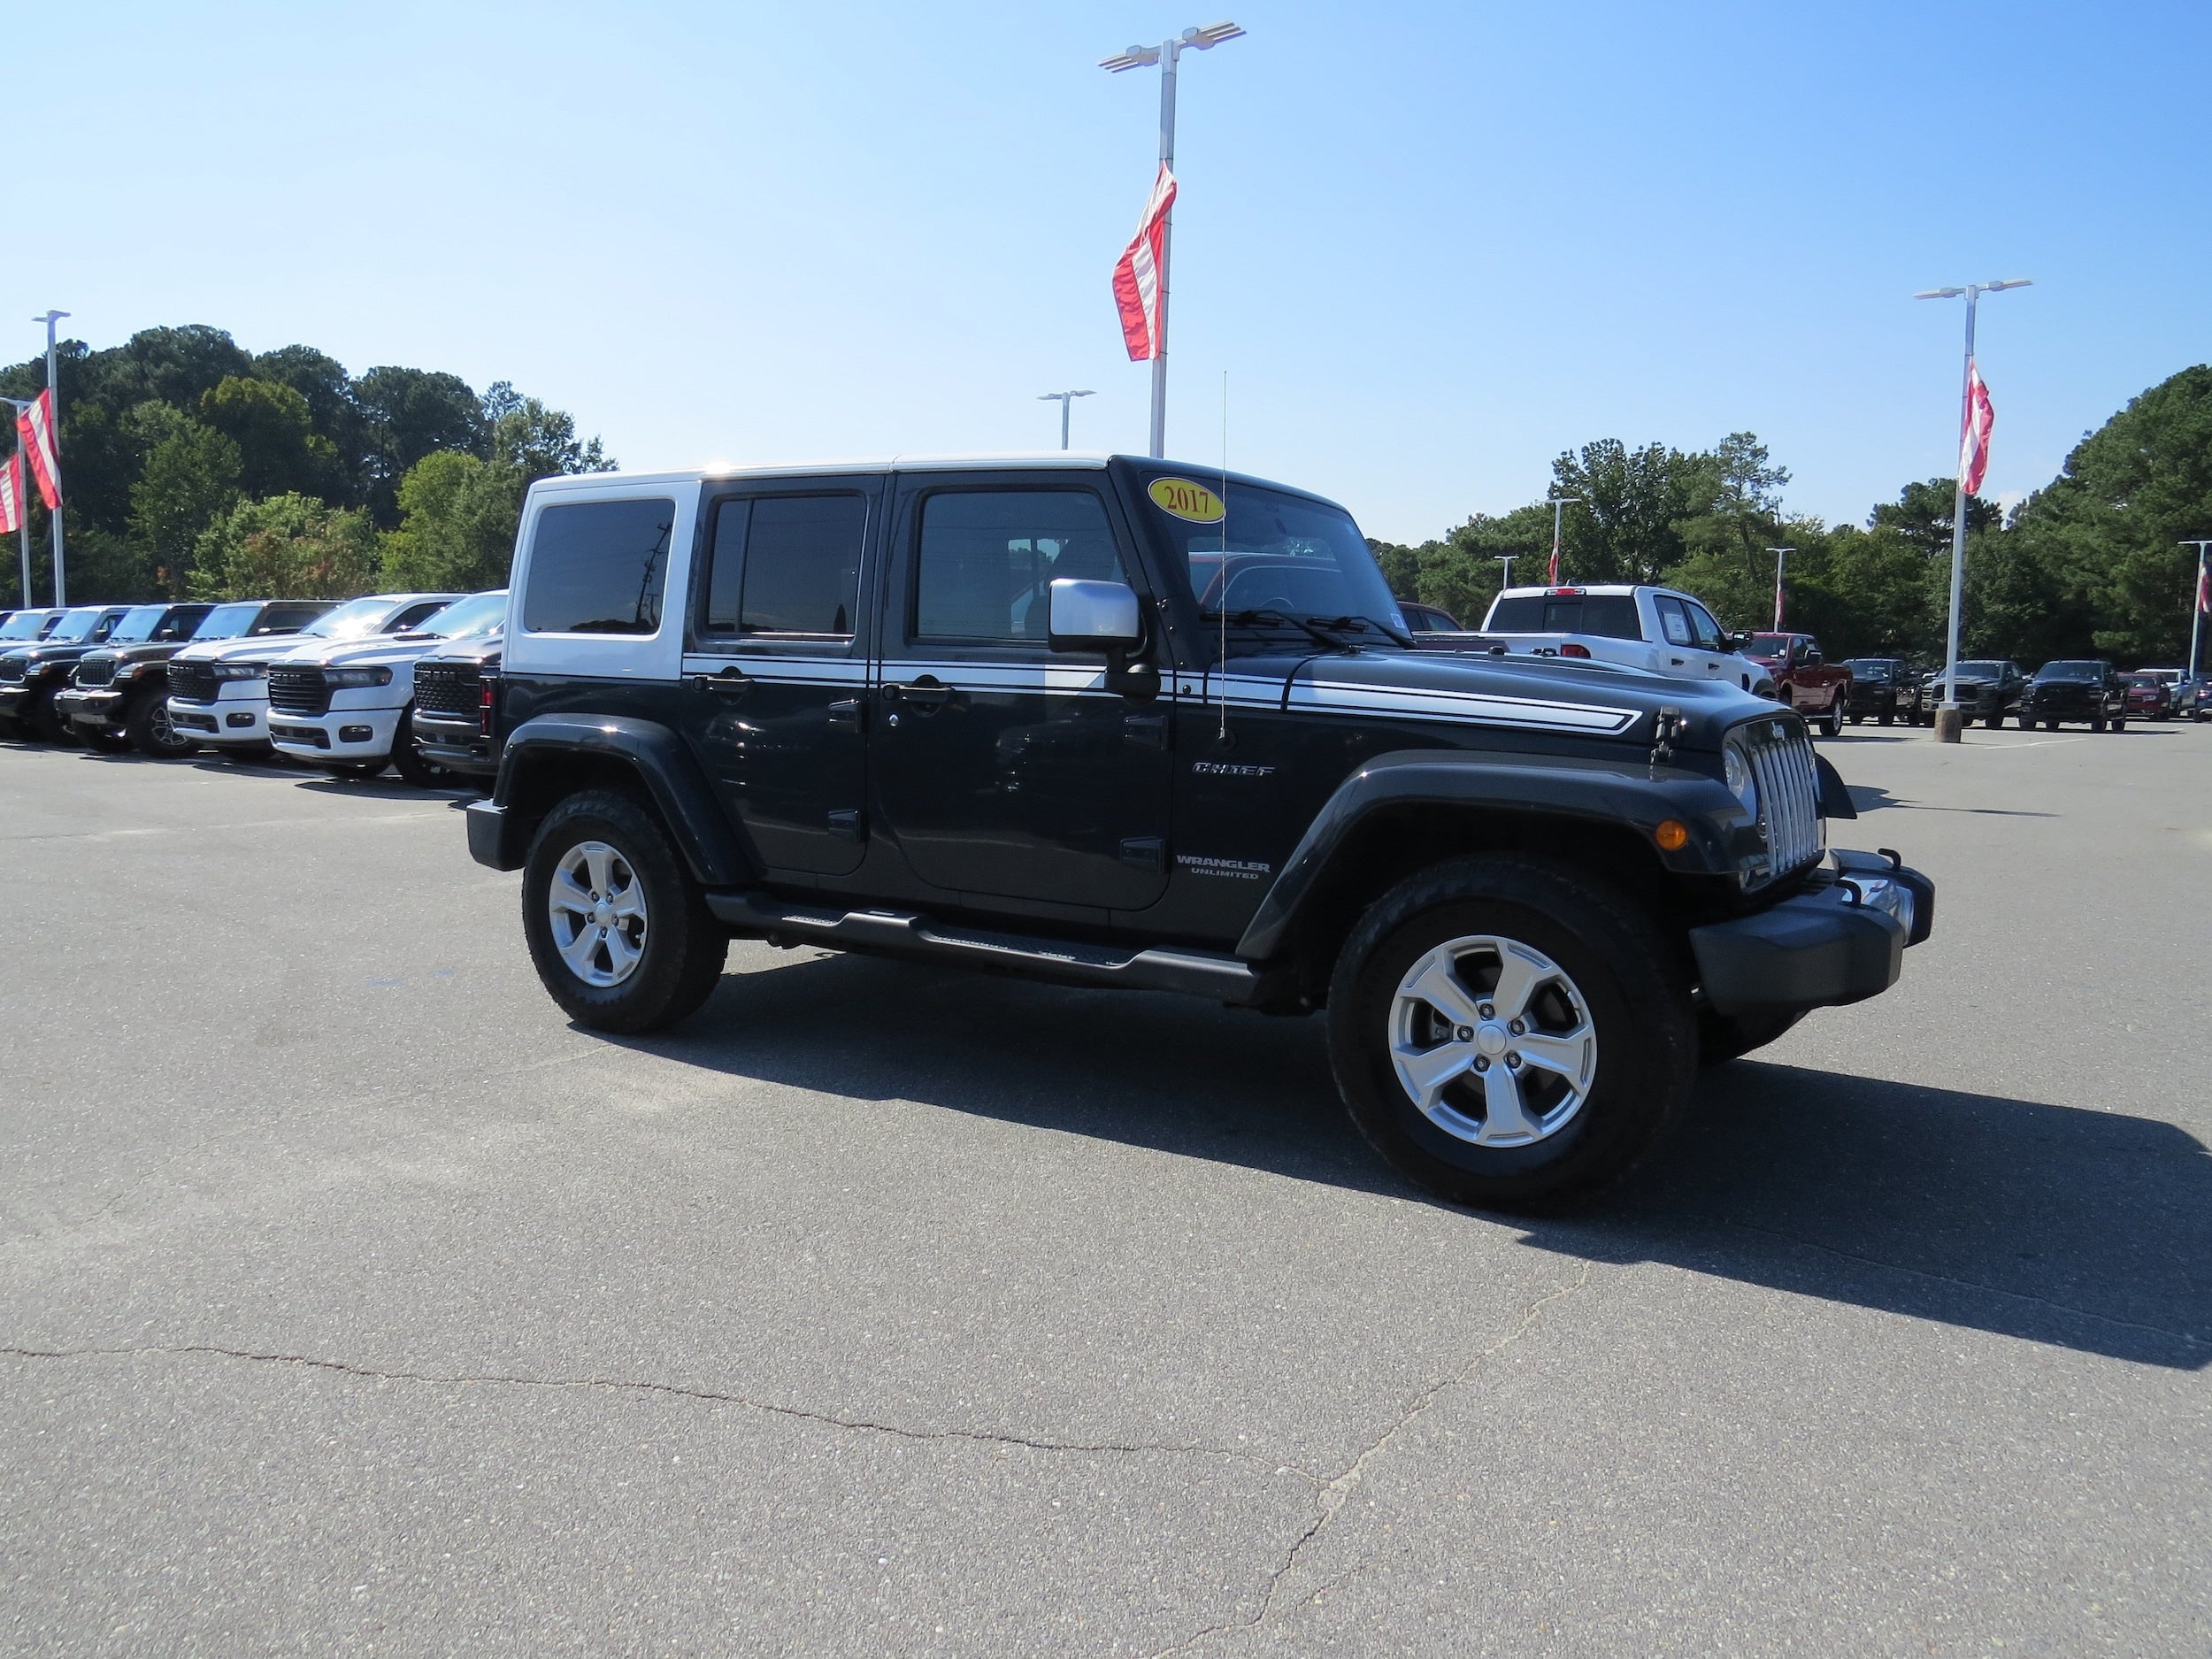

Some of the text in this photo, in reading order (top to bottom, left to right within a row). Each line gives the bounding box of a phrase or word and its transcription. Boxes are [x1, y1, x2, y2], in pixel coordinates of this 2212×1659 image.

[1164, 486, 1209, 514] 2017
[1193, 762, 1275, 777] CHIEF
[1177, 855, 1271, 872] WRANGLER
[1191, 867, 1259, 879] UNLIMITED
